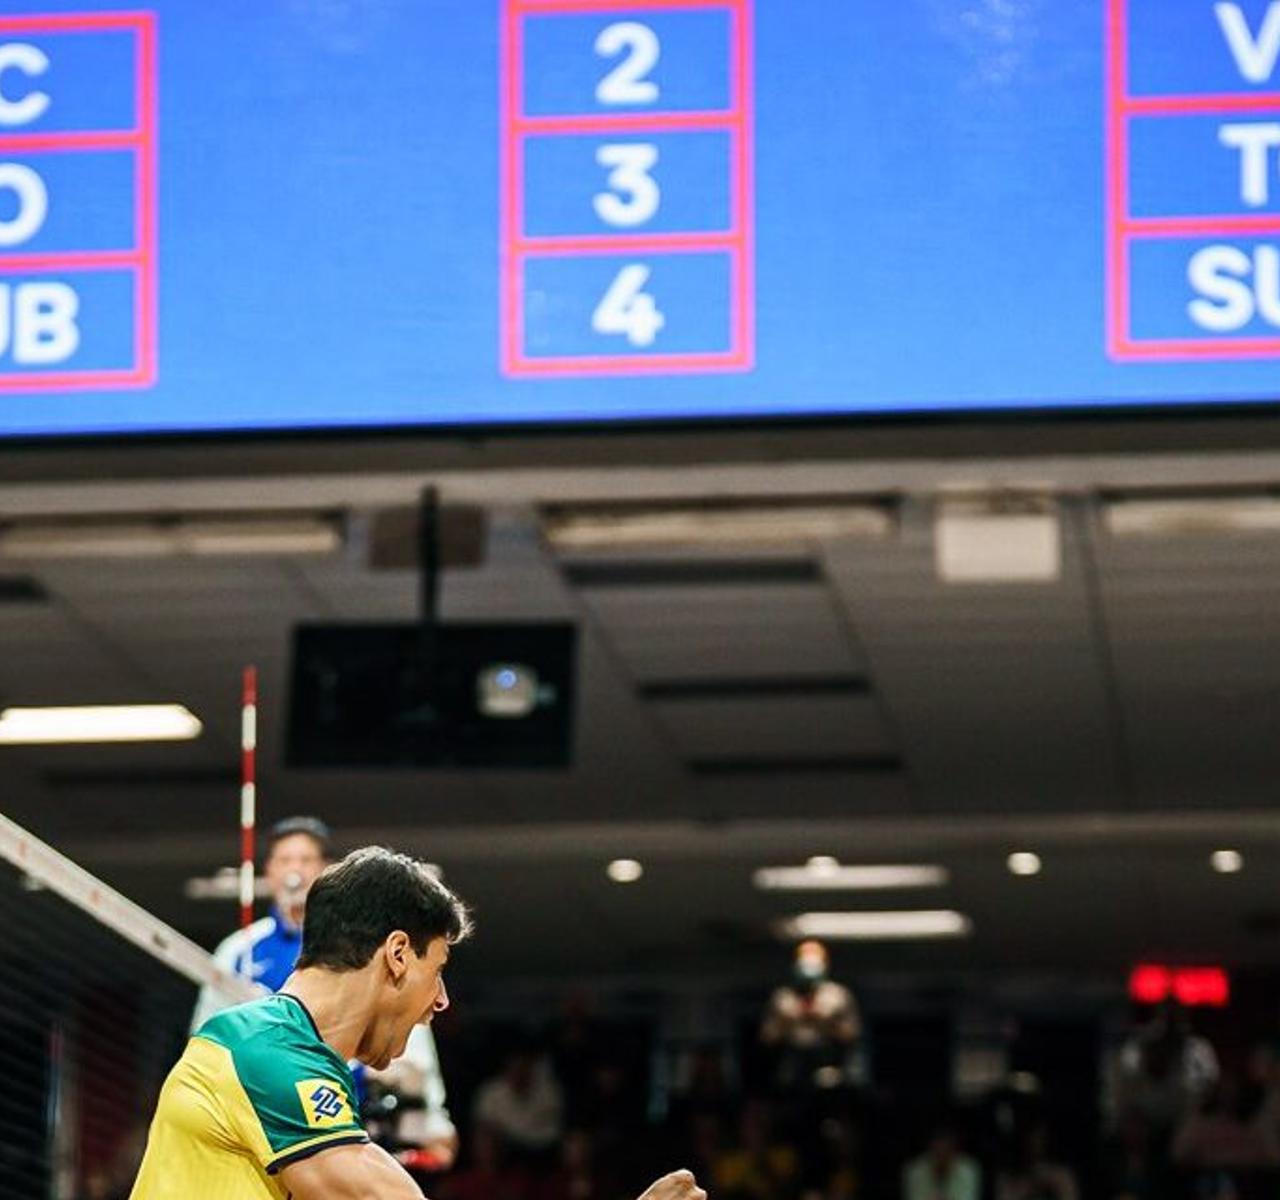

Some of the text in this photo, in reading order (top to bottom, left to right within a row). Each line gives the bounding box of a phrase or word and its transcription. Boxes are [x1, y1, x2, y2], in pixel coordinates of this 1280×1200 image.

[593, 22, 660, 104] 2
[593, 143, 660, 226] 3
[590, 264, 665, 346] 4
